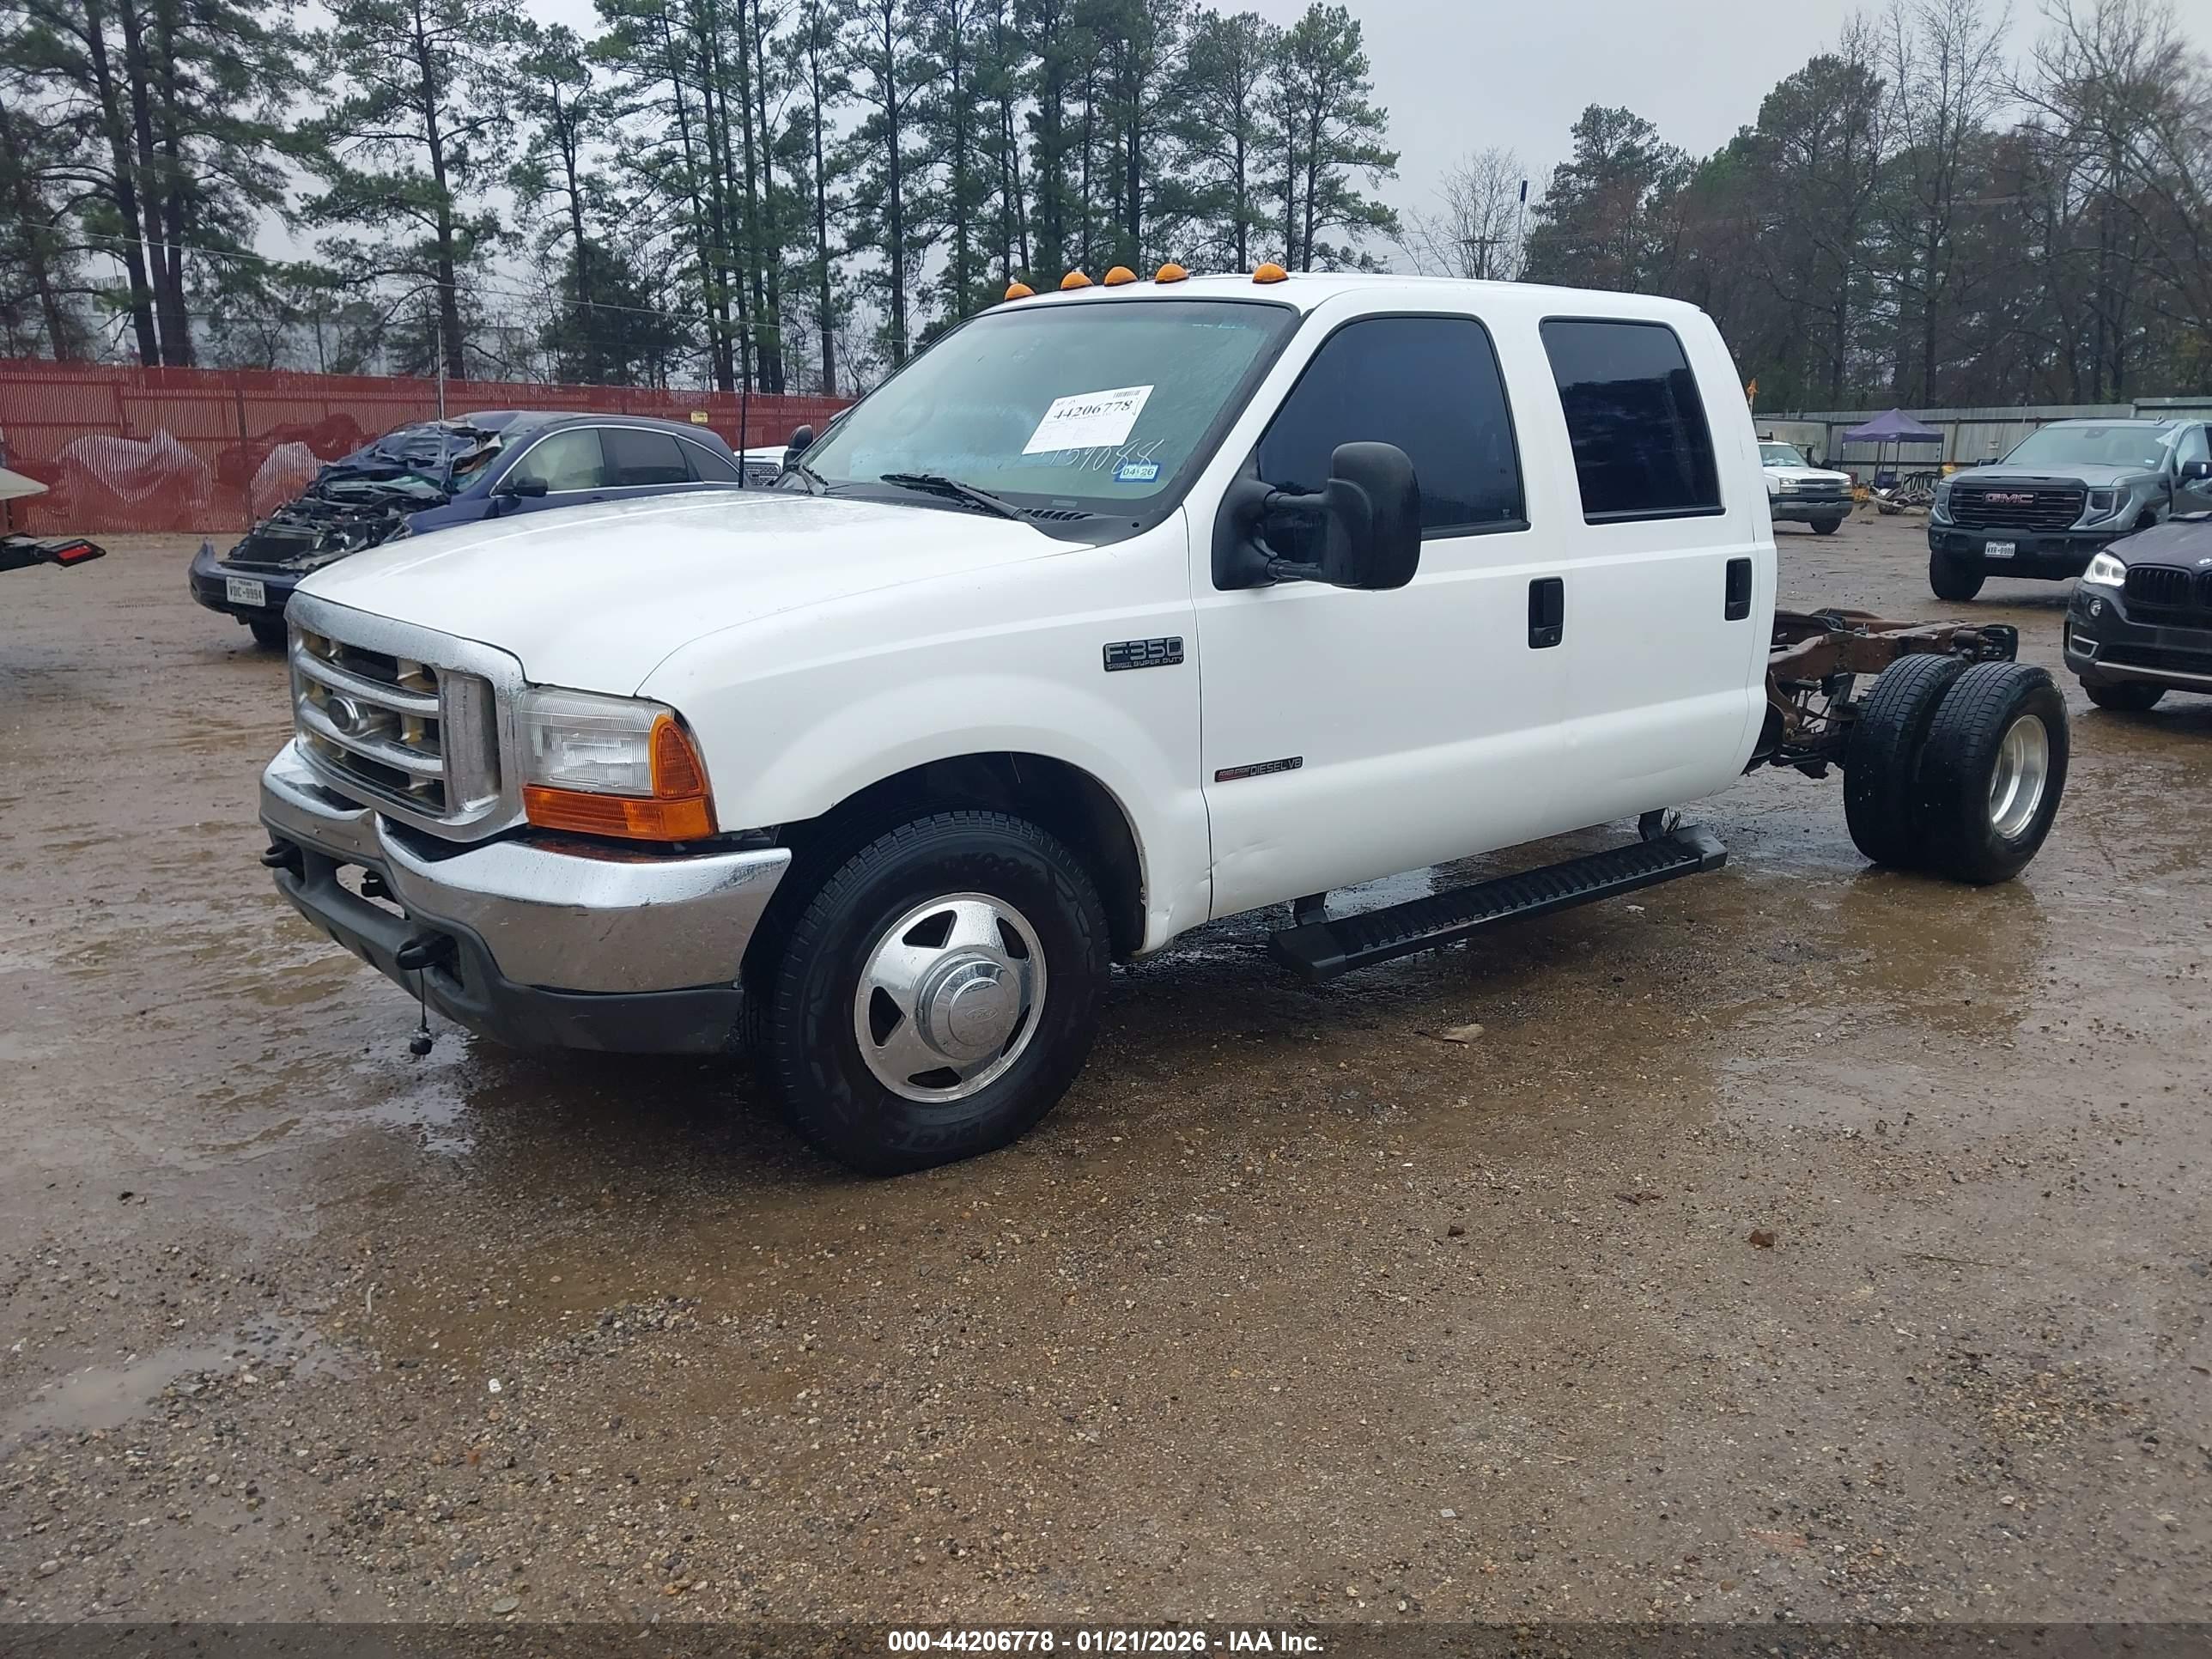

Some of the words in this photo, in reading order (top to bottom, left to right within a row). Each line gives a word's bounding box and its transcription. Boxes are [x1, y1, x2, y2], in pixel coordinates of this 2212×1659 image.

[1054, 400, 1133, 420] 44206778
[1985, 493, 2034, 504] GMC
[1105, 638, 1182, 663] F-350
[1133, 659, 1161, 667] SUPER
[1250, 762, 1286, 775] DIESEL
[1288, 757, 1302, 769] V8
